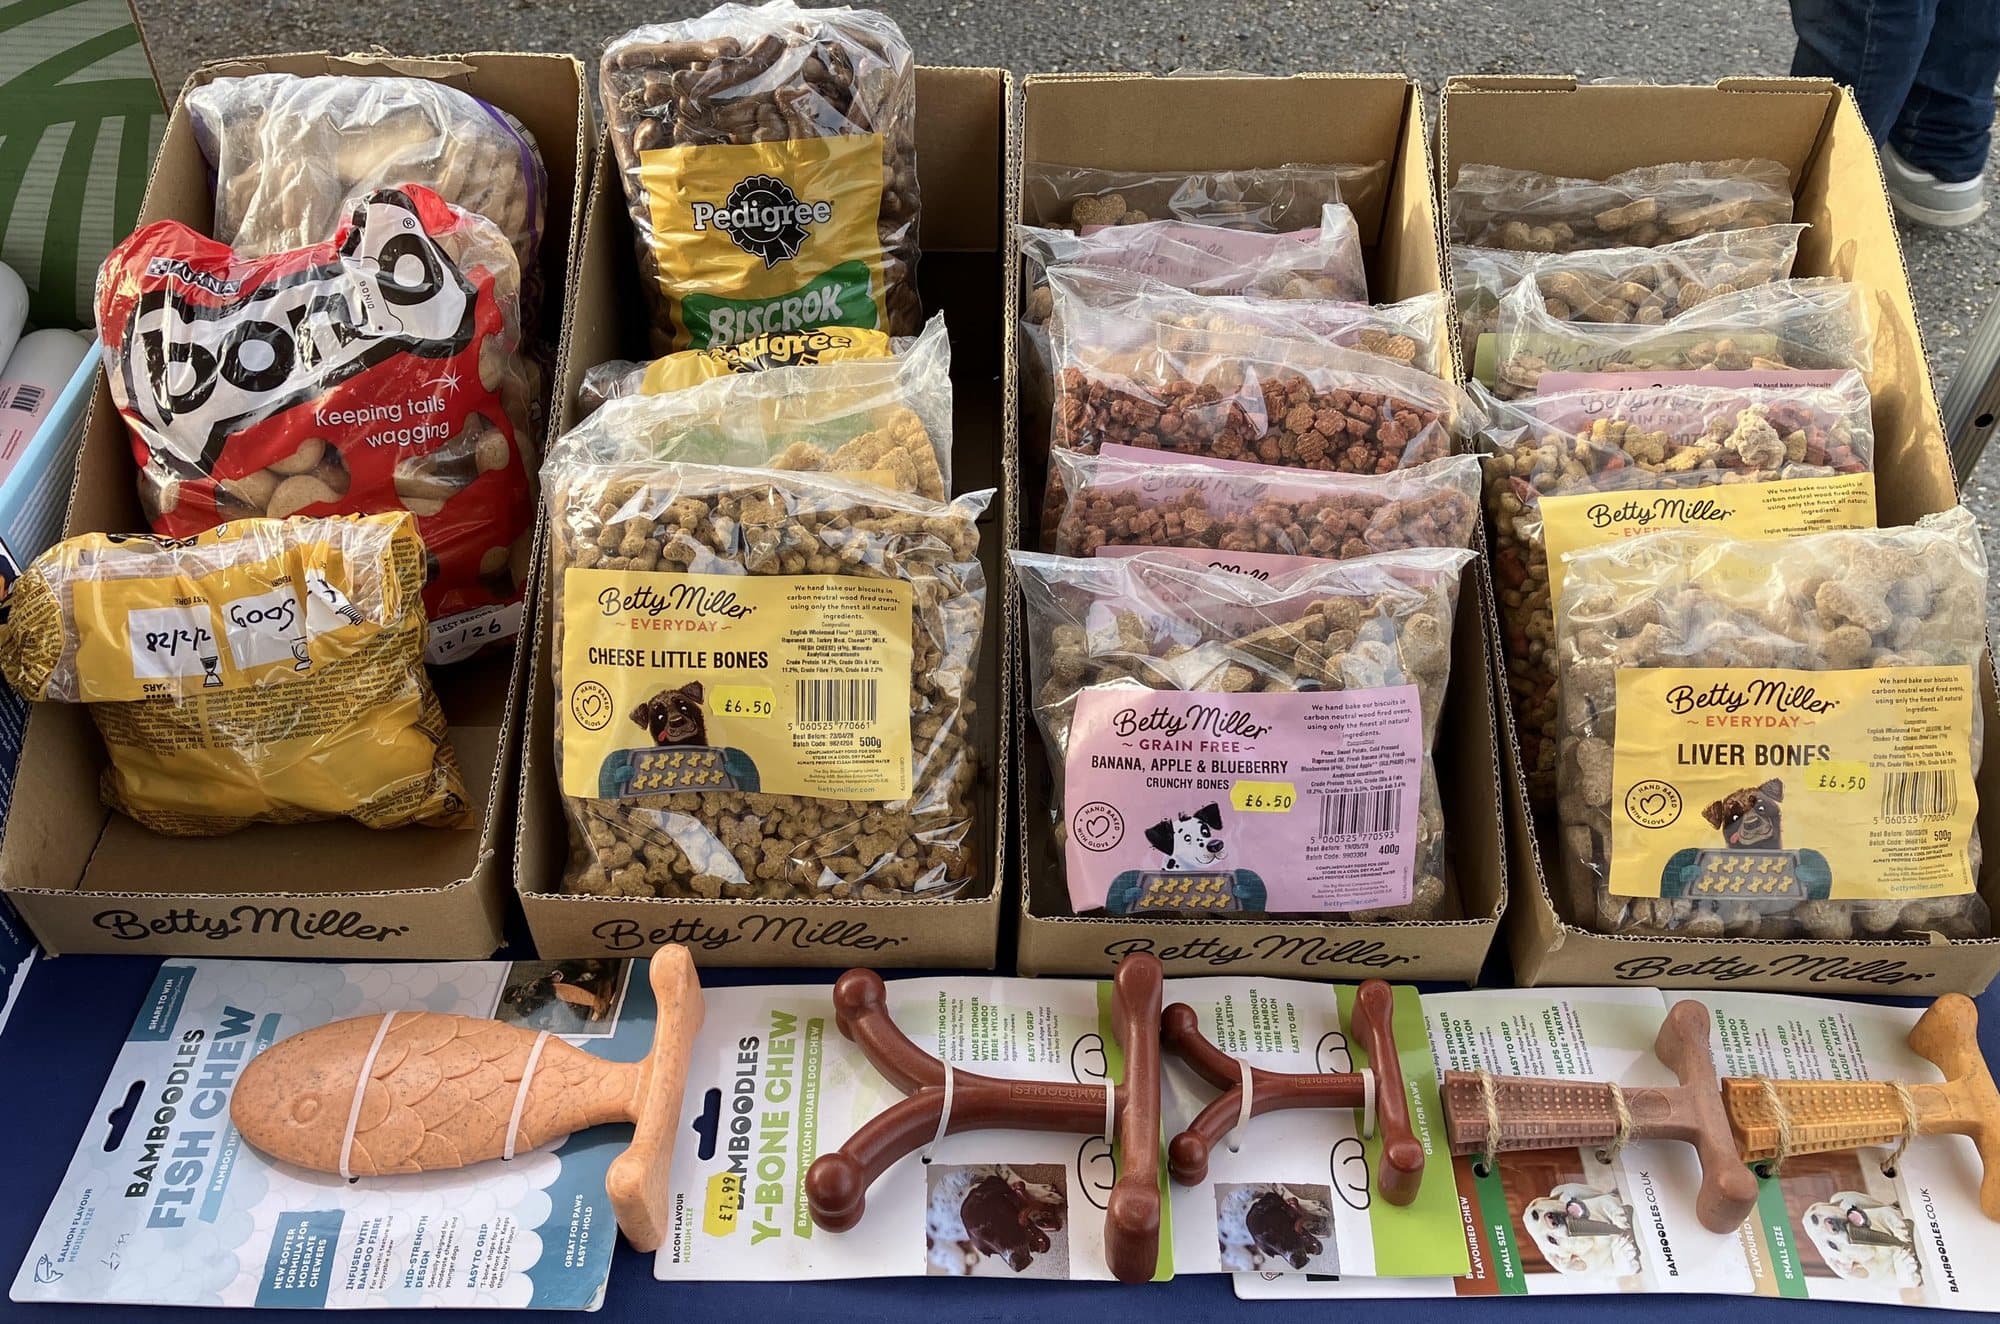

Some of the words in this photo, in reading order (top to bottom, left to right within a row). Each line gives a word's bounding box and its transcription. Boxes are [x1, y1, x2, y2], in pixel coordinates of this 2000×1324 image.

[693, 201, 832, 232] Pedigree
[708, 284, 843, 349] BISCROK
[315, 404, 401, 427] Keeping
[407, 397, 446, 417] tails
[365, 421, 450, 449] wagging
[1587, 501, 1657, 528] Betty
[1654, 498, 1732, 521] Miller
[599, 586, 672, 616] Betty
[669, 584, 752, 619] Miller
[631, 618, 718, 632] EVERYDAY
[589, 647, 645, 667] CHEESE
[651, 651, 707, 668] LITTLE
[713, 651, 768, 669] BONES
[724, 700, 772, 715] £6.50
[1666, 682, 1749, 714] Betty
[1747, 679, 1835, 714] Miller
[788, 722, 793, 730] 5
[799, 722, 833, 730] 060525
[838, 722, 870, 730] 770661
[1113, 707, 1188, 737] Betty
[1186, 705, 1267, 739] Miller
[1342, 730, 1381, 739] ingredients.
[1706, 716, 1801, 728] EVERYDAY
[860, 736, 881, 748] 500g
[1139, 739, 1193, 751] GRAIN
[1200, 741, 1240, 753] FREE
[1677, 744, 1745, 766] LIVER
[1755, 744, 1831, 766] BONES
[1091, 755, 1146, 773] BANANA,
[1151, 759, 1192, 773] APPLE
[1196, 761, 1206, 773] &
[1211, 760, 1288, 774] BLUEBERRY
[1146, 777, 1193, 789] CRUNCHY
[1196, 778, 1229, 790] BONES
[1819, 774, 1866, 790] £6.50
[1245, 795, 1291, 808] £6.50
[1872, 816, 1878, 824] 5
[1885, 815, 1919, 824] 060525
[1310, 836, 1315, 844] 5
[1322, 835, 1357, 844] 060525
[1362, 831, 1394, 841] 770593
[1378, 844, 1400, 855] 400g
[1934, 830, 1952, 841] 500g
[92, 908, 242, 940] Betty
[230, 905, 402, 942] Miller
[593, 918, 742, 950] Betty
[738, 915, 900, 951] Miller
[1104, 936, 1253, 966] Betty
[1252, 935, 1411, 969] Miller
[1614, 955, 1768, 981] Betty
[1768, 954, 1931, 986] Miller
[1225, 995, 1237, 1052] LONG-LASTING
[1250, 989, 1261, 1029] STRONGER
[1260, 998, 1271, 1031] BAMBOO
[1552, 1006, 1564, 1037] TARTAR
[811, 1026, 820, 1054] CHEW
[1239, 1029, 1248, 1052] CHEW
[1254, 1031, 1263, 1052] MADE
[1501, 1021, 1512, 1042] GRIP
[1543, 1009, 1557, 1048] CONTROL
[1715, 1009, 1731, 1053] STRONGER
[764, 1010, 798, 1104] CHEW
[1264, 1035, 1273, 1052] WITH
[1506, 1043, 1514, 1055] TO
[808, 1056, 817, 1080] DOG
[1509, 1056, 1520, 1076] EASY
[1551, 1051, 1562, 1075] HELPS
[1560, 1043, 1575, 1075] PLAQUE
[1725, 1054, 1736, 1076] MADE
[804, 1082, 816, 1127] DURABLE
[1411, 1081, 1425, 1107] PAWS
[125, 1028, 205, 1198] BAMBOODLES
[146, 1131, 216, 1229] FISH
[189, 1005, 256, 1120] CHEW
[1419, 1107, 1431, 1126] FOR
[1422, 1126, 1433, 1155] GREAT
[212, 1148, 233, 1192] BAMBOO
[751, 1111, 790, 1245] Y-BONE
[574, 1194, 584, 1219] PAWS
[675, 1193, 684, 1228] FLAVOUR
[719, 1177, 736, 1221] £7.99
[1458, 1196, 1473, 1221] CHEW
[58, 1227, 76, 1263] SALMON
[73, 1188, 92, 1227] FLAVOUR
[570, 1219, 578, 1238] FOR
[583, 1206, 593, 1230] HOLD
[1640, 1171, 1678, 1276] BAMBOODLES.CO.UK
[68, 1227, 87, 1263] MEDIUM
[84, 1207, 96, 1226] SIZE
[477, 1223, 489, 1247] GRIP
[581, 1229, 589, 1245] TO
[673, 1229, 681, 1263] BACON
[1494, 1225, 1504, 1246] SIZE
[1773, 1225, 1784, 1247] SIZE
[1919, 1187, 1959, 1293] BAMBOODLES.CO.UK
[274, 1267, 285, 1289] NEW
[280, 1228, 296, 1266] SOFTER
[285, 1242, 304, 1289] FORMULA
[298, 1221, 309, 1239] FOR
[298, 1235, 316, 1288] MODERATE
[310, 1239, 327, 1287] CHEWERS
[346, 1247, 362, 1290] INFUSED
[358, 1220, 370, 1244] WITH
[357, 1247, 374, 1289] BAMBOO
[369, 1217, 383, 1245] FIBRE
[404, 1215, 428, 1288] MID-STRENGTH
[475, 1247, 483, 1261] TO
[564, 1239, 577, 1268] GREAT
[576, 1243, 587, 1267] EASY
[1463, 1221, 1485, 1279] FLAVOURED
[1499, 1247, 1514, 1279] SMALL
[1747, 1223, 1763, 1278] FLAVOURED
[1780, 1247, 1794, 1280] SMALL
[415, 1250, 431, 1288] DESIGN
[467, 1261, 480, 1289] EASY
